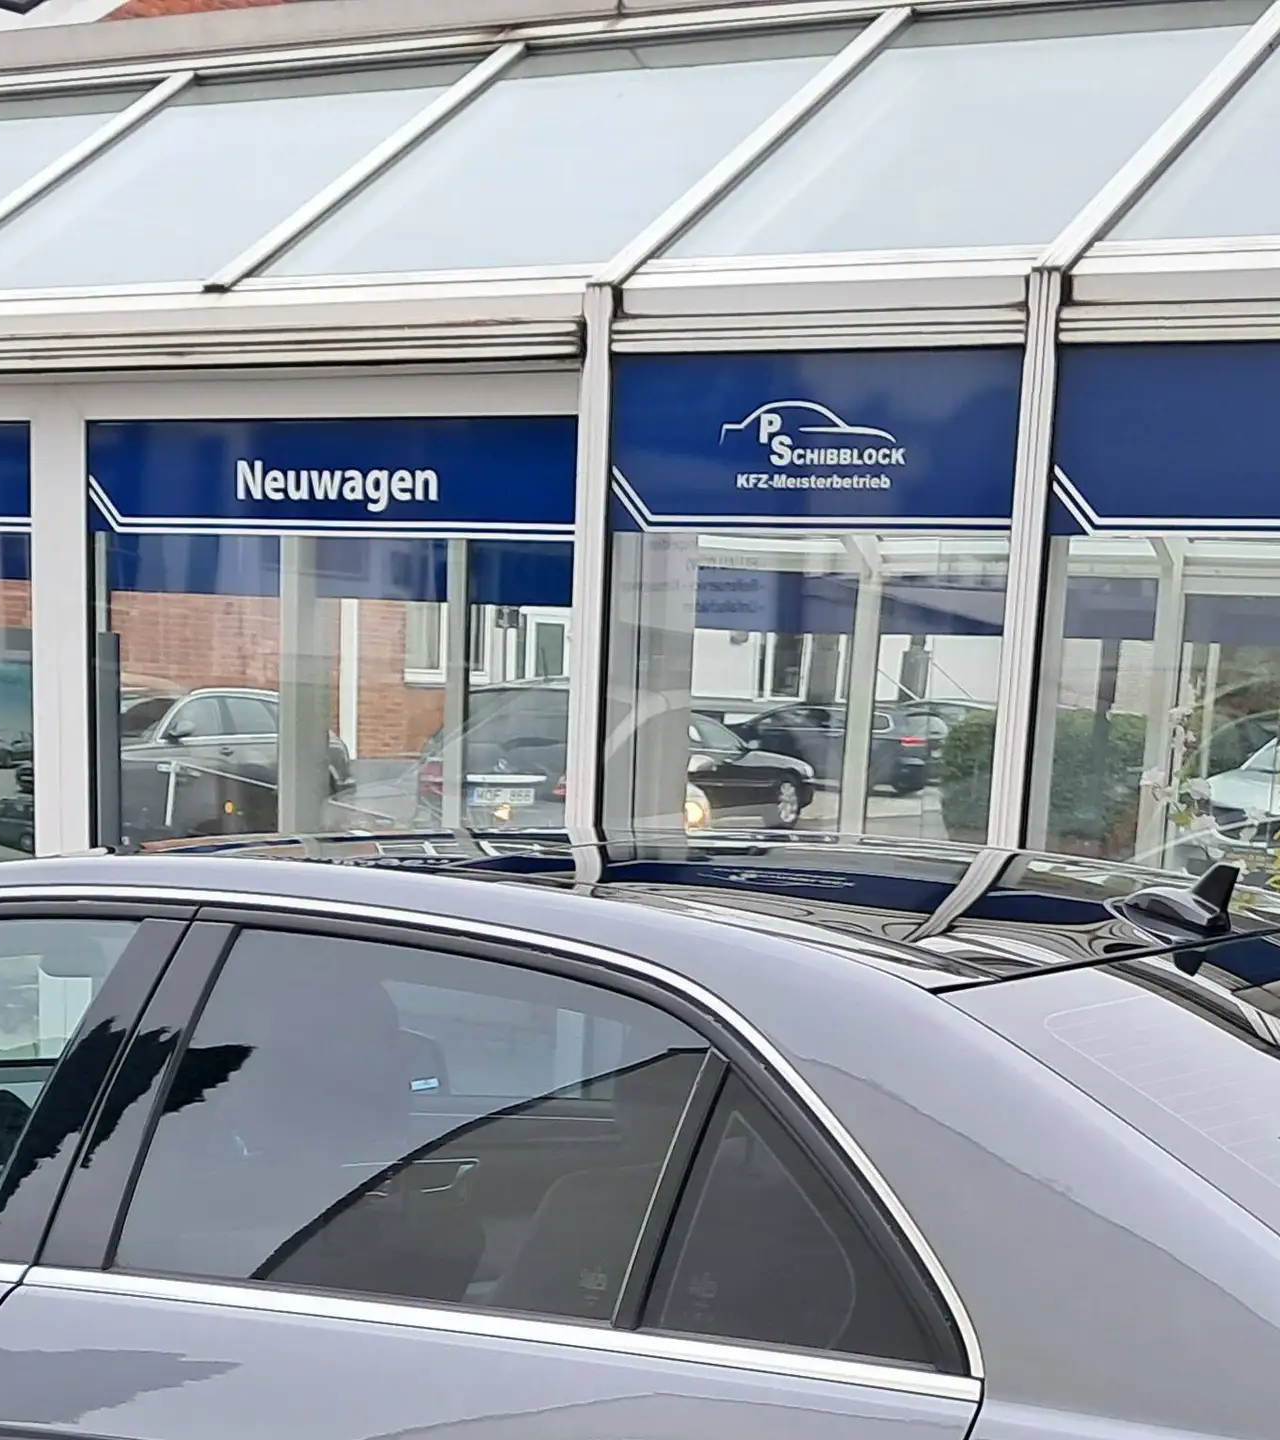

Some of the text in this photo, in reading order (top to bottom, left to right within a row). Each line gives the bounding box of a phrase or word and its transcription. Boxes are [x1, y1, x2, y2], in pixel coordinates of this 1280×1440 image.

[770, 435, 907, 466] SCHIBBLOCK
[236, 459, 439, 512] Neuwagen
[736, 473, 891, 489] KFZ-Meisterbetrieb
